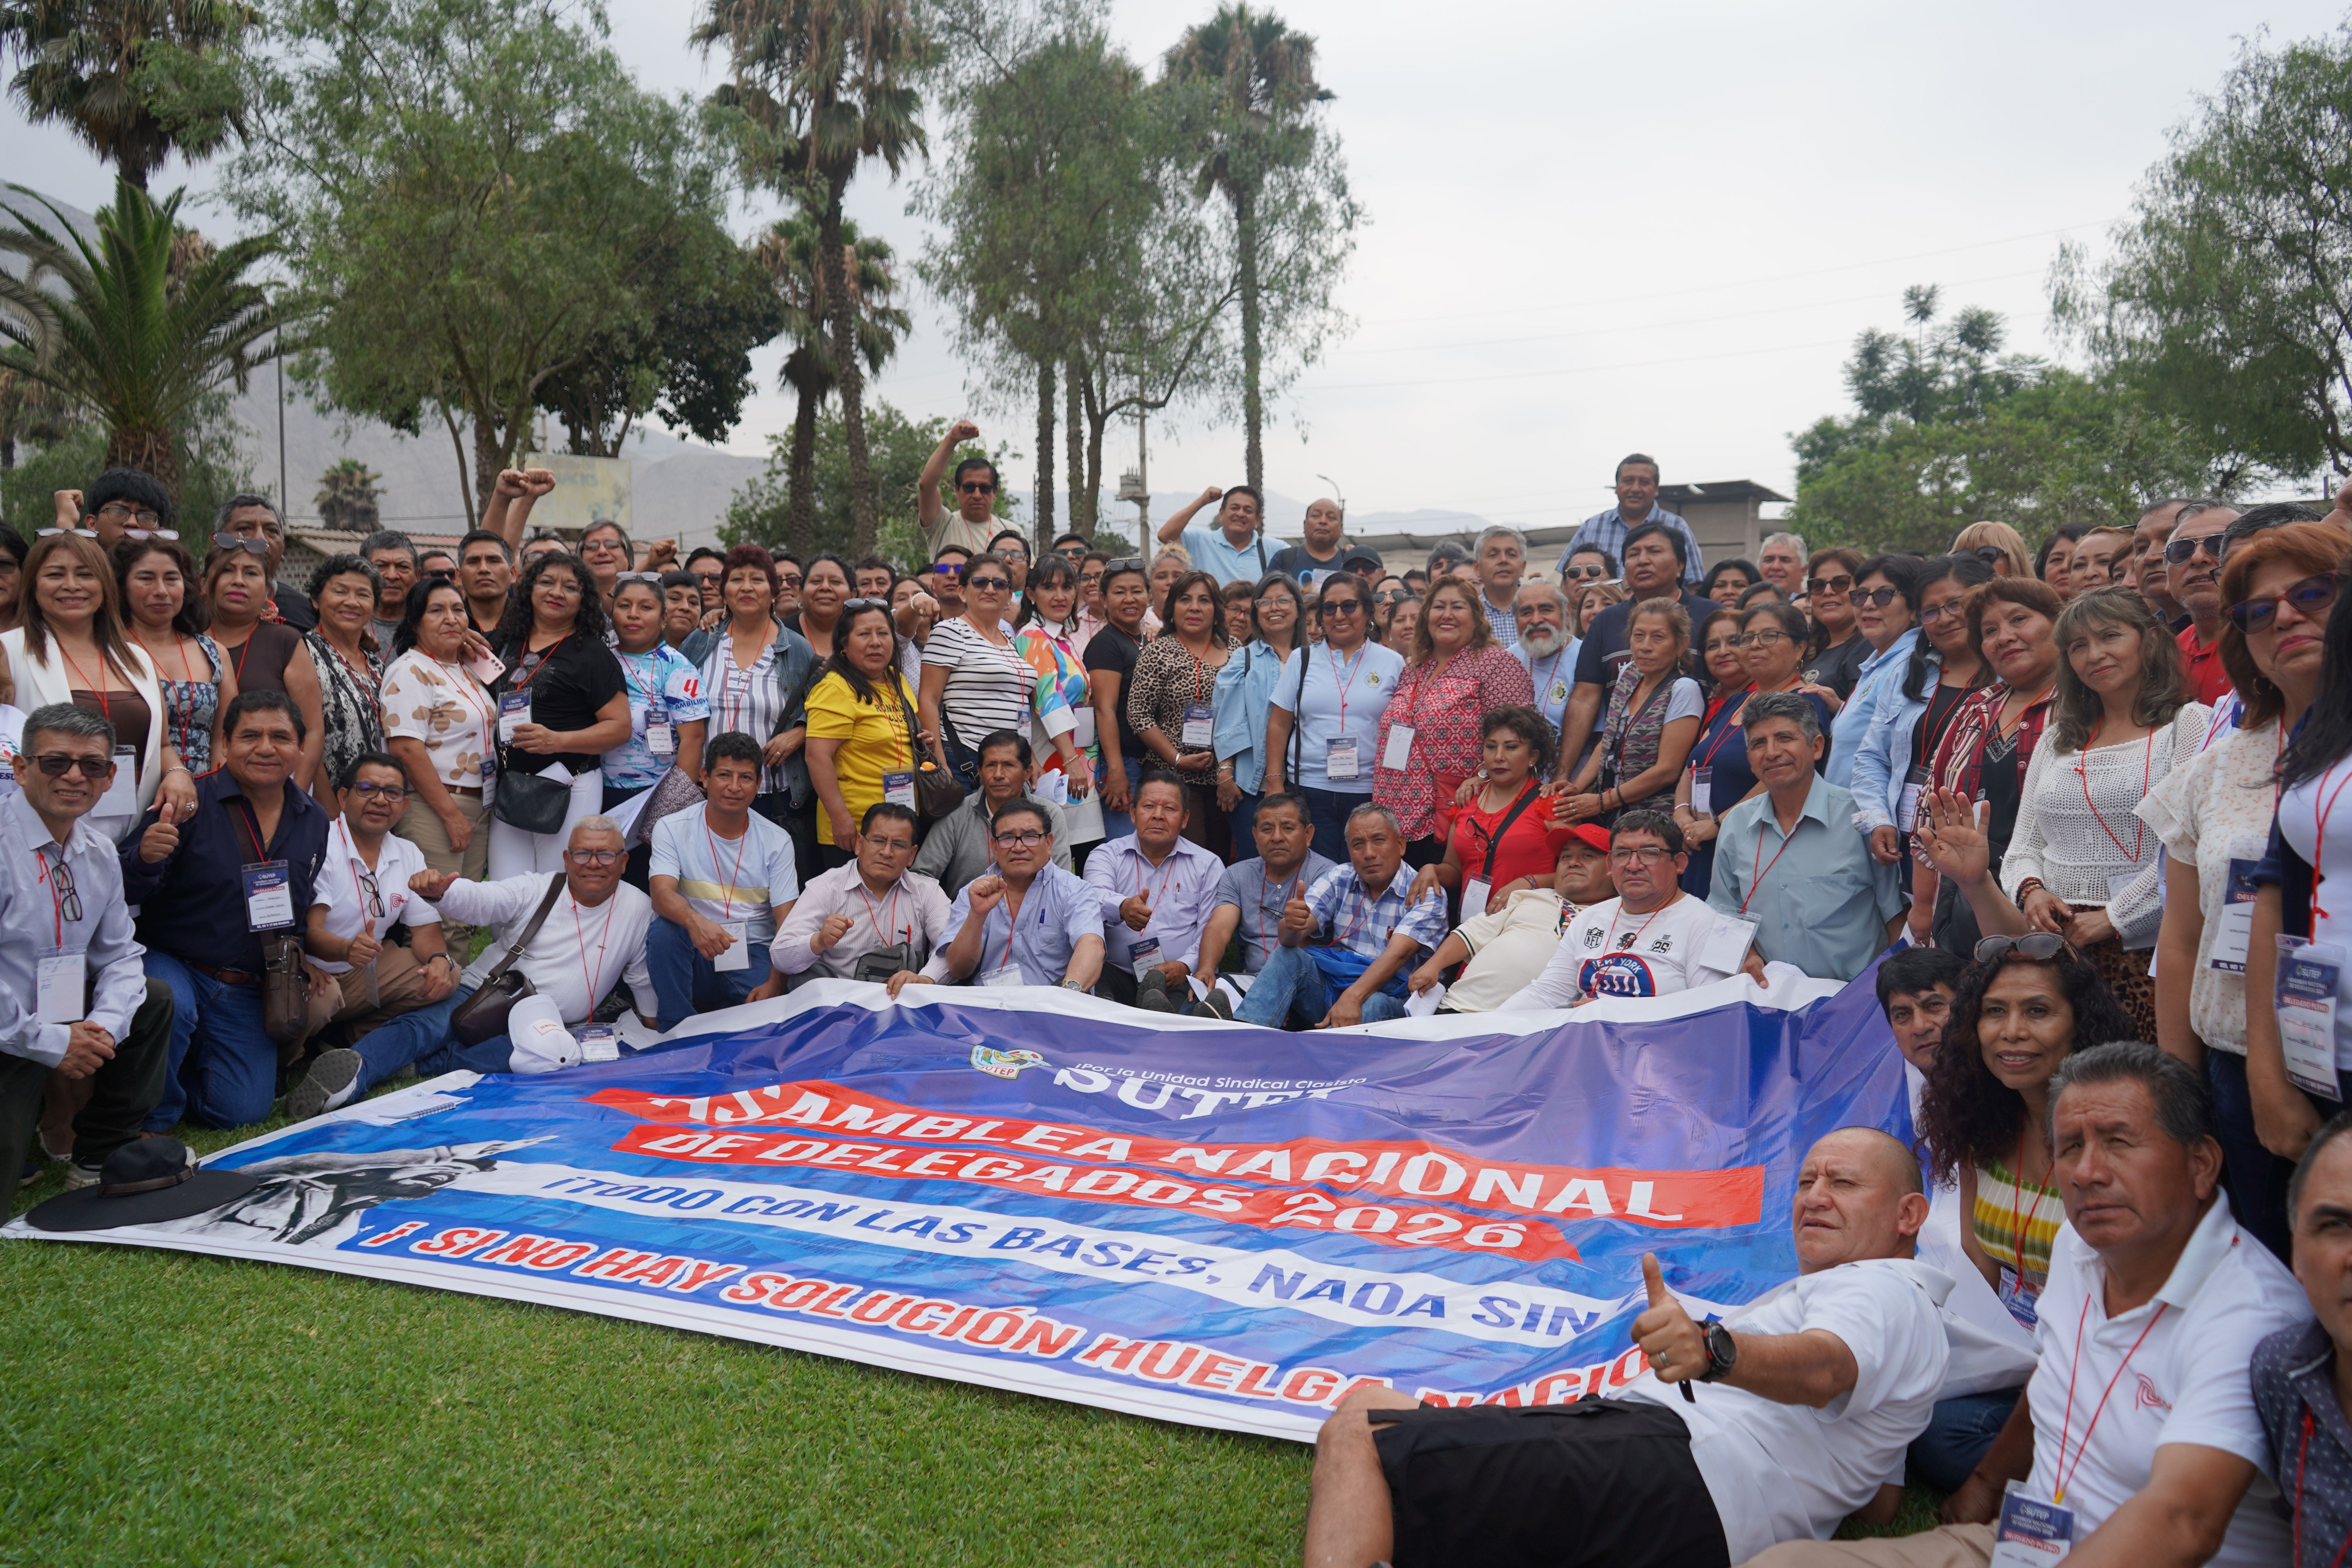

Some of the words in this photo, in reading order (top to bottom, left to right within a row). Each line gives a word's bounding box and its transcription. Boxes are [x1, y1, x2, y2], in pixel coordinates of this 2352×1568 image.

[875, 704, 904, 712] RUNNIN
[1586, 936, 1600, 946] NFL
[1649, 941, 1670, 953] 25
[1590, 958, 1616, 970] NEW
[1620, 958, 1643, 974] YORK
[2301, 968, 2321, 979] SUTEP
[1074, 1063, 1114, 1073] ¡Por
[1116, 1068, 1136, 1076] la
[1141, 1071, 1210, 1087] Unidad
[1214, 1077, 1290, 1089] Sindical
[1295, 1077, 1367, 1089] Clasista
[1053, 1067, 1350, 1120] SUTE
[639, 1133, 765, 1158] DE
[755, 1140, 1254, 1212] DELEGADOS
[1269, 1192, 1527, 1248] 2026
[1158, 1147, 1683, 1221] NACIONAL
[540, 1176, 725, 1210] ¡TODO
[720, 1195, 860, 1222] CON
[853, 1209, 988, 1243] LAS
[988, 1226, 1222, 1285] BASES,
[1247, 1263, 1446, 1319] NADA
[1471, 1296, 1601, 1338] SIN
[416, 1229, 502, 1256] SI
[481, 1236, 593, 1268] NO
[579, 1249, 740, 1291] HAY
[726, 1274, 1080, 1356] SOLUCIÓN
[1081, 1336, 1386, 1407] HUELGA
